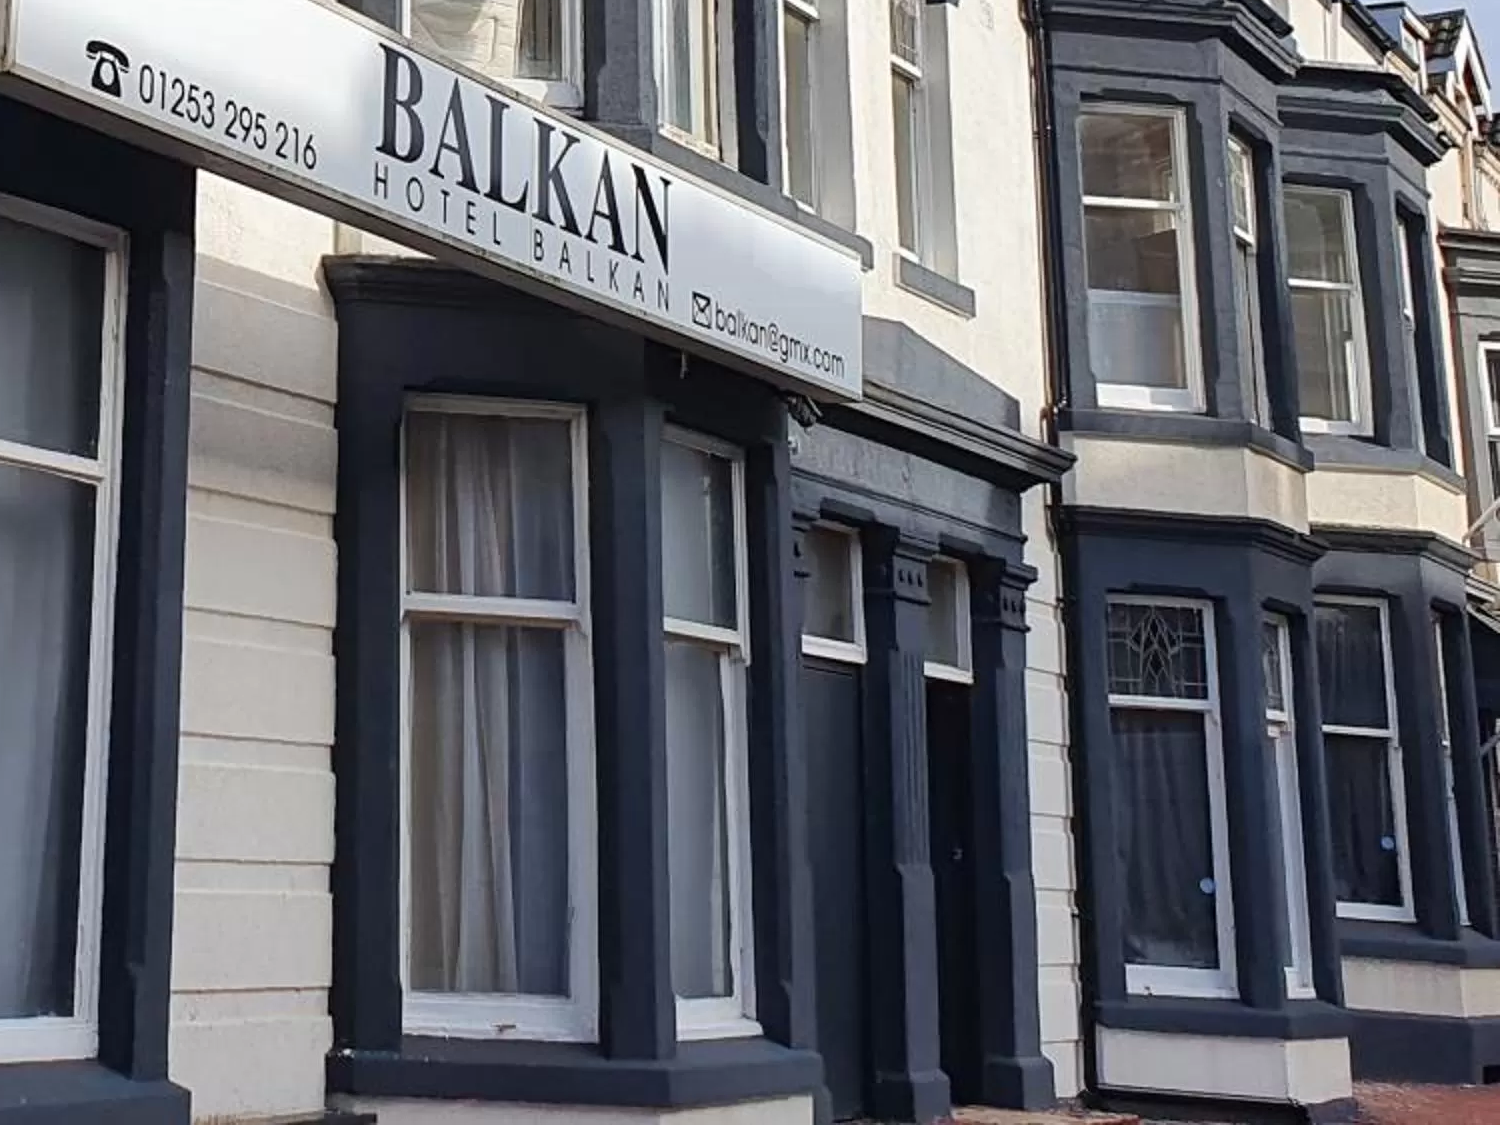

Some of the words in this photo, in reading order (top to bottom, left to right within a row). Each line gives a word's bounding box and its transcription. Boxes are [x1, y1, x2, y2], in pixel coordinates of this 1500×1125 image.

[139, 64, 216, 129] 01253
[224, 100, 268, 150] 295
[275, 121, 318, 170] 216
[375, 42, 672, 276] BALKAN
[374, 161, 501, 246] HOTEL
[532, 228, 670, 313] BALKAN
[715, 300, 845, 379] balkan@gmx.com
